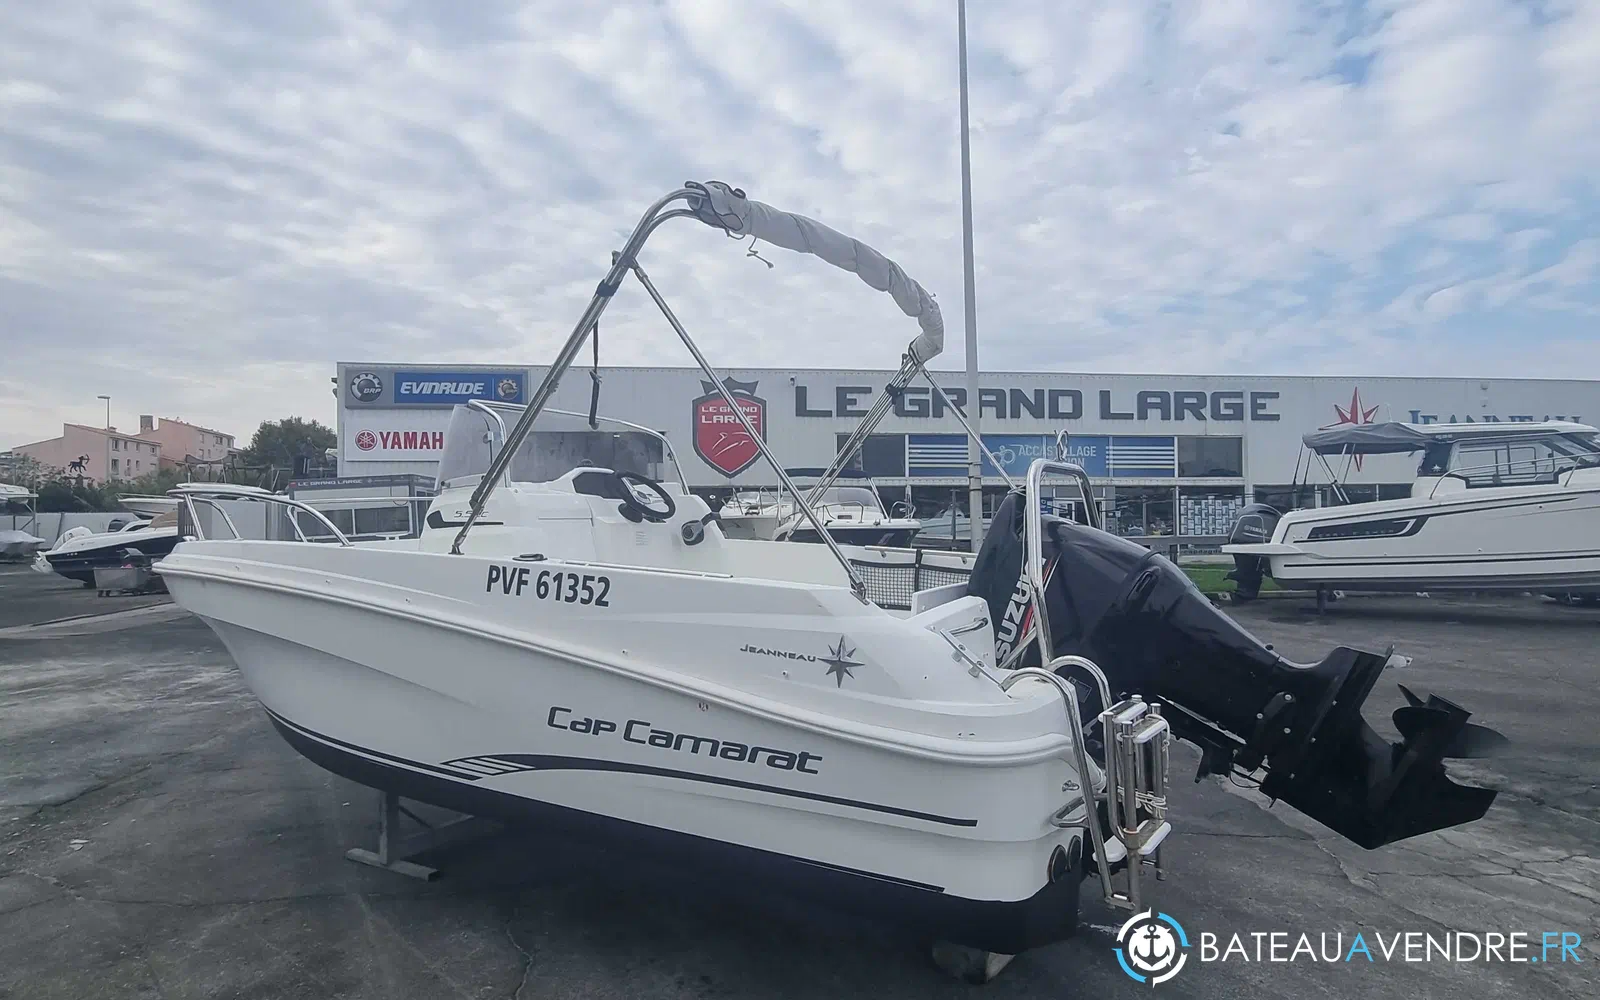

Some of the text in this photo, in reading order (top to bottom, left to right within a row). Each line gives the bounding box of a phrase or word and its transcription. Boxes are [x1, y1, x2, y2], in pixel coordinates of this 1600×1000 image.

[400, 382, 485, 395] EVINRUDE
[795, 386, 1280, 421] LE GRAND LARGE
[379, 431, 444, 450] YAMAH
[486, 565, 611, 608] PVF 61352
[996, 557, 1047, 664] SUZUK
[740, 644, 816, 662] JEANNEAU
[623, 719, 823, 775] Camarat
